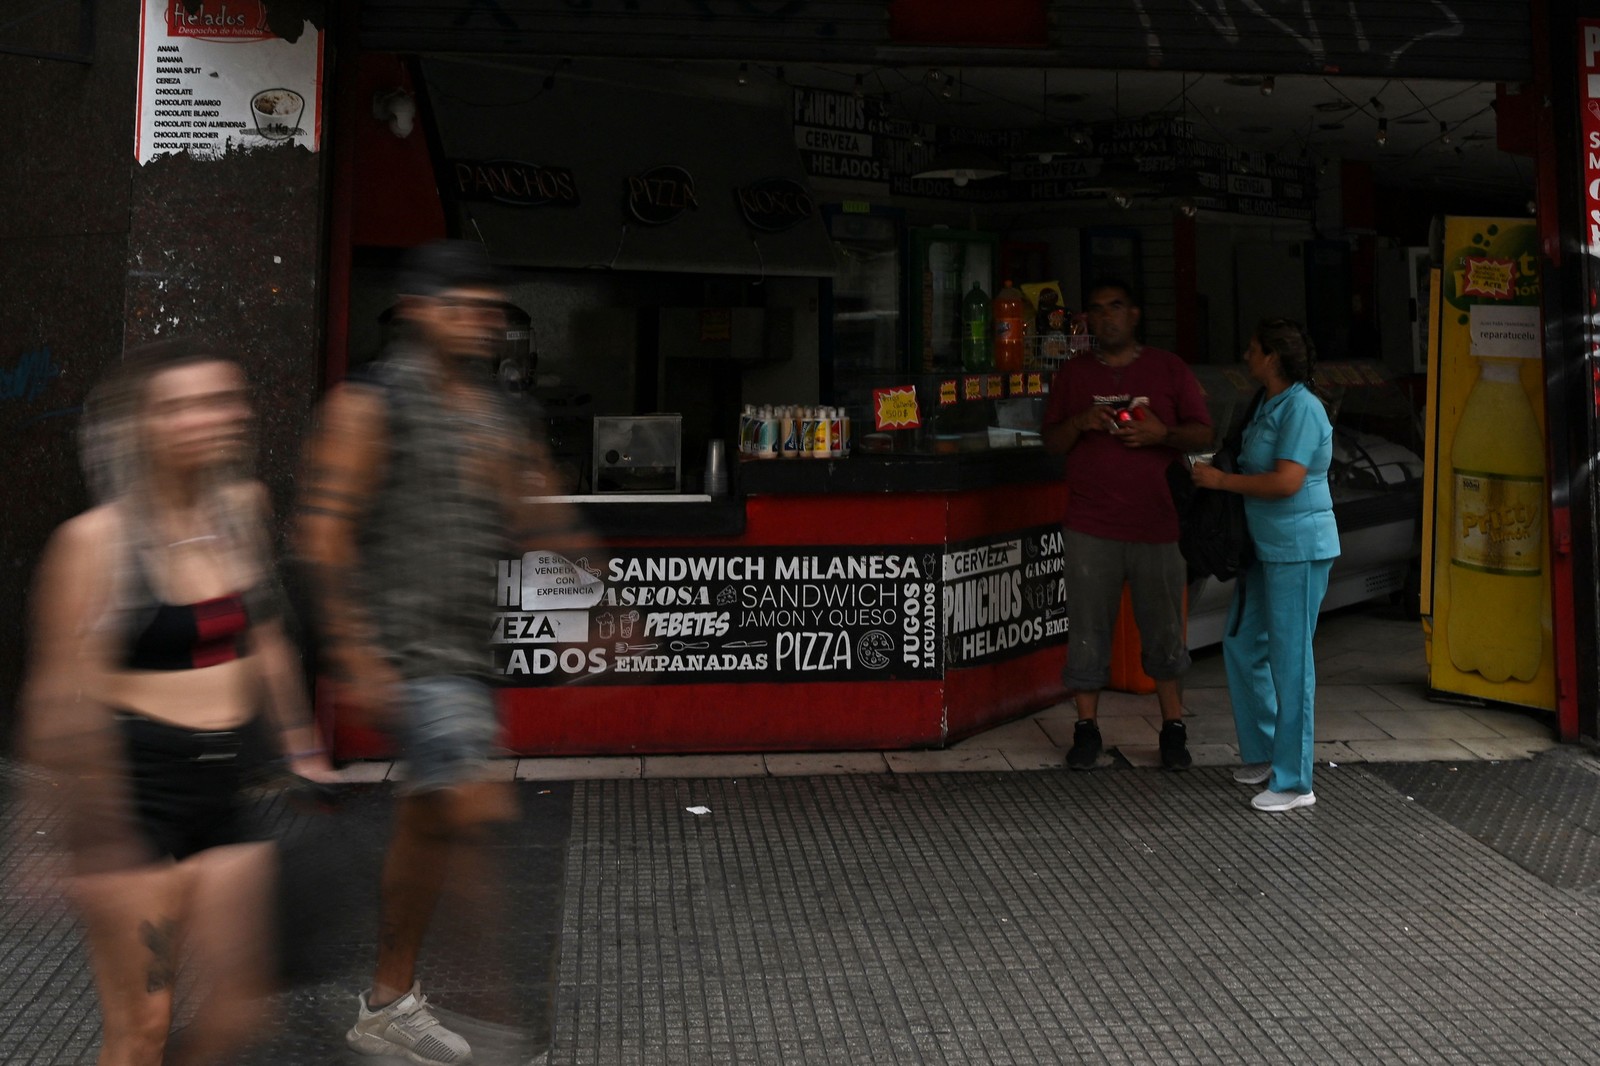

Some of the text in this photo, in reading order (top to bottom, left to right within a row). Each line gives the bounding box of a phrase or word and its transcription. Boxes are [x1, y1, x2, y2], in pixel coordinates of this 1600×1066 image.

[174, 3, 245, 27] Helados
[178, 26, 217, 35] Despacho
[231, 27, 263, 35] helados
[154, 120, 192, 128] CHOCOLATE
[276, 123, 288, 135] Kg
[805, 131, 860, 153] CERVEZA
[812, 153, 880, 179] HELADOS
[456, 163, 574, 200] PANCHOS
[628, 175, 699, 208] PIZZA
[737, 184, 814, 217] KIOSCO
[1480, 331, 1535, 341] reparatucelu
[538, 556, 550, 564] SE
[608, 556, 764, 582] SANDWICH
[954, 550, 1009, 574] CERVEZA
[537, 587, 594, 596] EXPERIENCIA
[600, 585, 711, 607] ASEOSA
[741, 583, 898, 609] SANDWICH
[943, 569, 1022, 637] PANCHOS
[643, 610, 731, 638] PEBETES
[738, 608, 898, 628] JAMON Y QUESO
[903, 582, 921, 669] JUGOS
[924, 582, 936, 669] LICUADOS
[776, 630, 852, 672] PIZZA
[962, 616, 1043, 661] HELADOS
[614, 653, 769, 673] EMPANADAS
